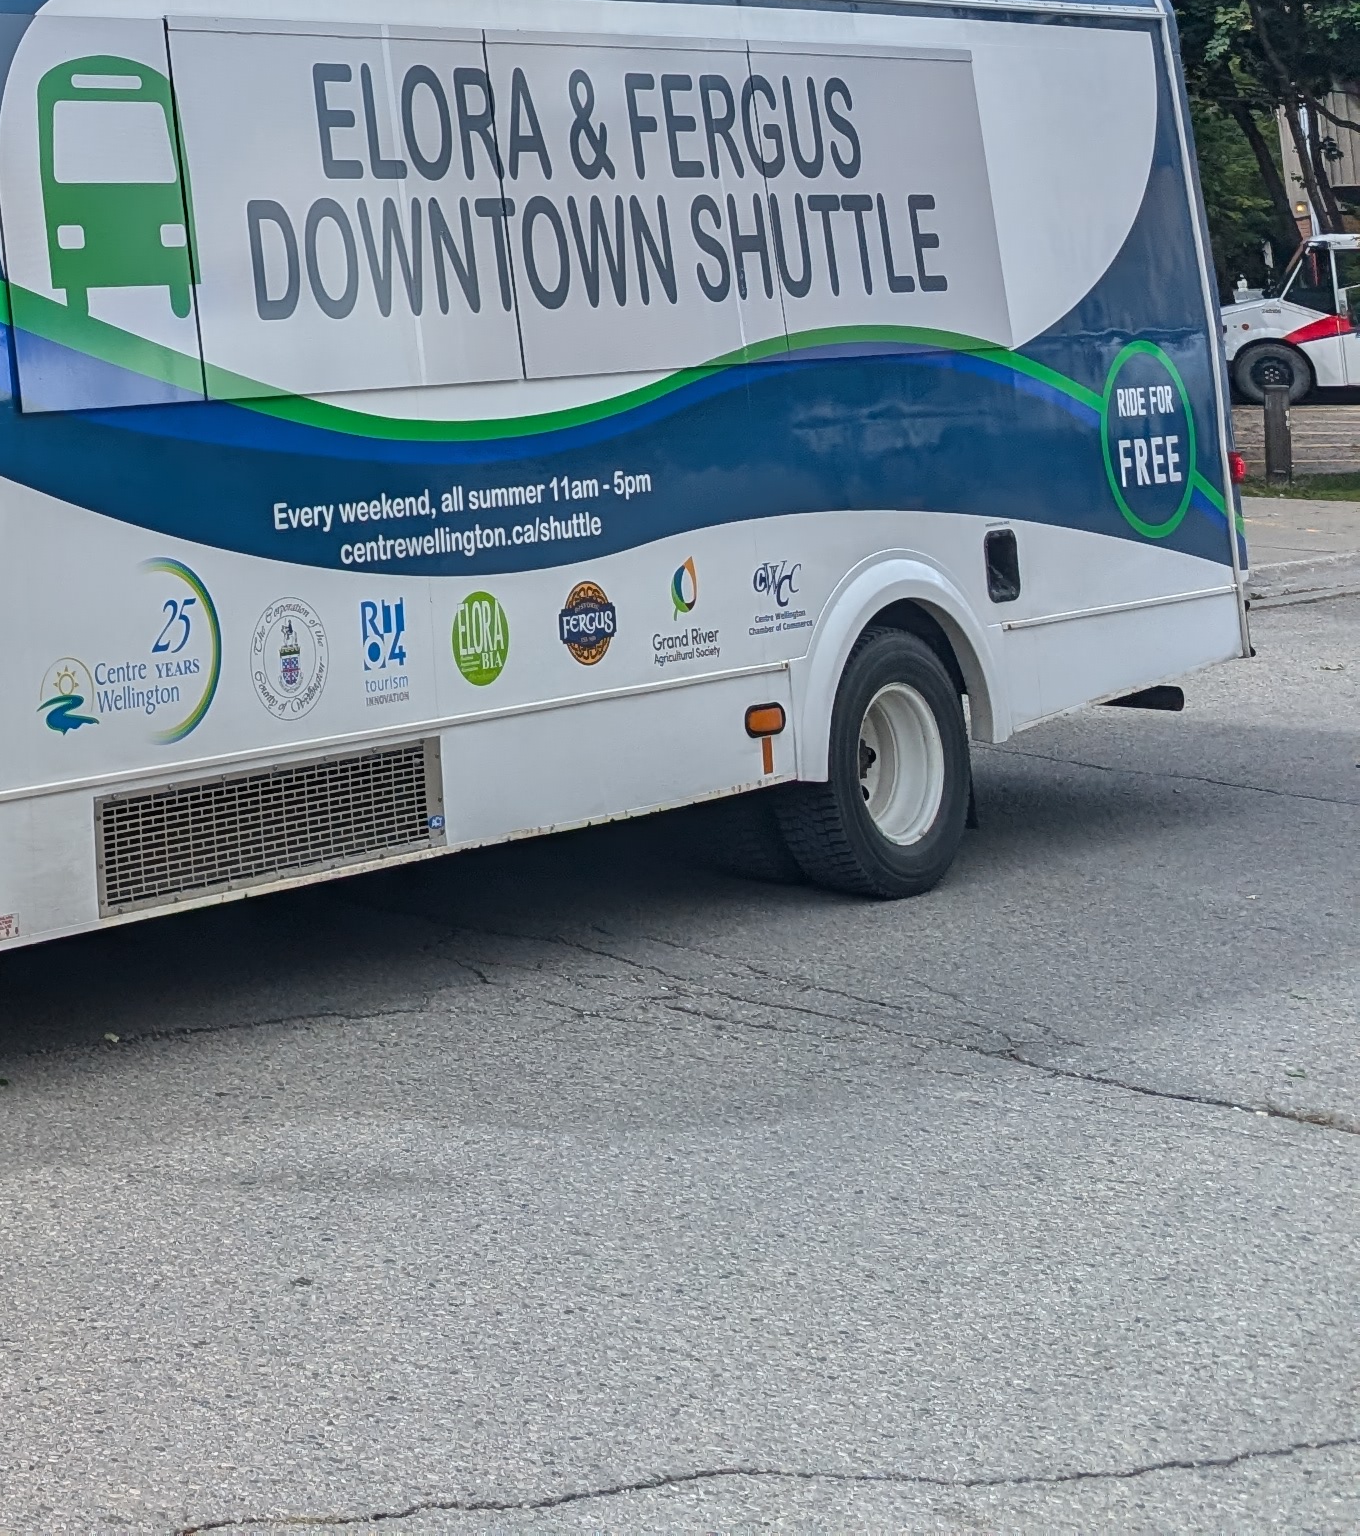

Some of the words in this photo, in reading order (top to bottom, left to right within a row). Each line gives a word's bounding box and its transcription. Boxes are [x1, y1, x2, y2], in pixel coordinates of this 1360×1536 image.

[312, 62, 553, 184] ELORA
[569, 68, 617, 181] &
[624, 72, 863, 181] FERGUS
[246, 194, 679, 322] DOWNTOWN
[691, 193, 949, 304] SHUTTLE
[1117, 387, 1146, 417] RIDE
[1149, 385, 1174, 415] FOR
[1118, 435, 1182, 487] FREE
[273, 502, 334, 532] Every
[339, 488, 437, 524] weekend,
[441, 485, 463, 513] all
[468, 483, 545, 510] summer
[549, 475, 599, 501] 11am
[613, 470, 651, 500] 5pm
[340, 512, 602, 564] centrewellington.ca/shuttle
[151, 598, 197, 653] 25
[457, 598, 504, 656] ELORA
[562, 610, 614, 640] FERGUS
[653, 629, 689, 651] Grand
[691, 627, 719, 646] River
[155, 658, 200, 679] YEARS
[482, 651, 503, 670] BIA
[654, 649, 694, 666] Agricultural
[696, 646, 720, 659] Society
[94, 661, 147, 686] Centre
[365, 675, 409, 693] tourism
[96, 684, 180, 715] Wellington
[366, 691, 410, 706] INNOVATION
